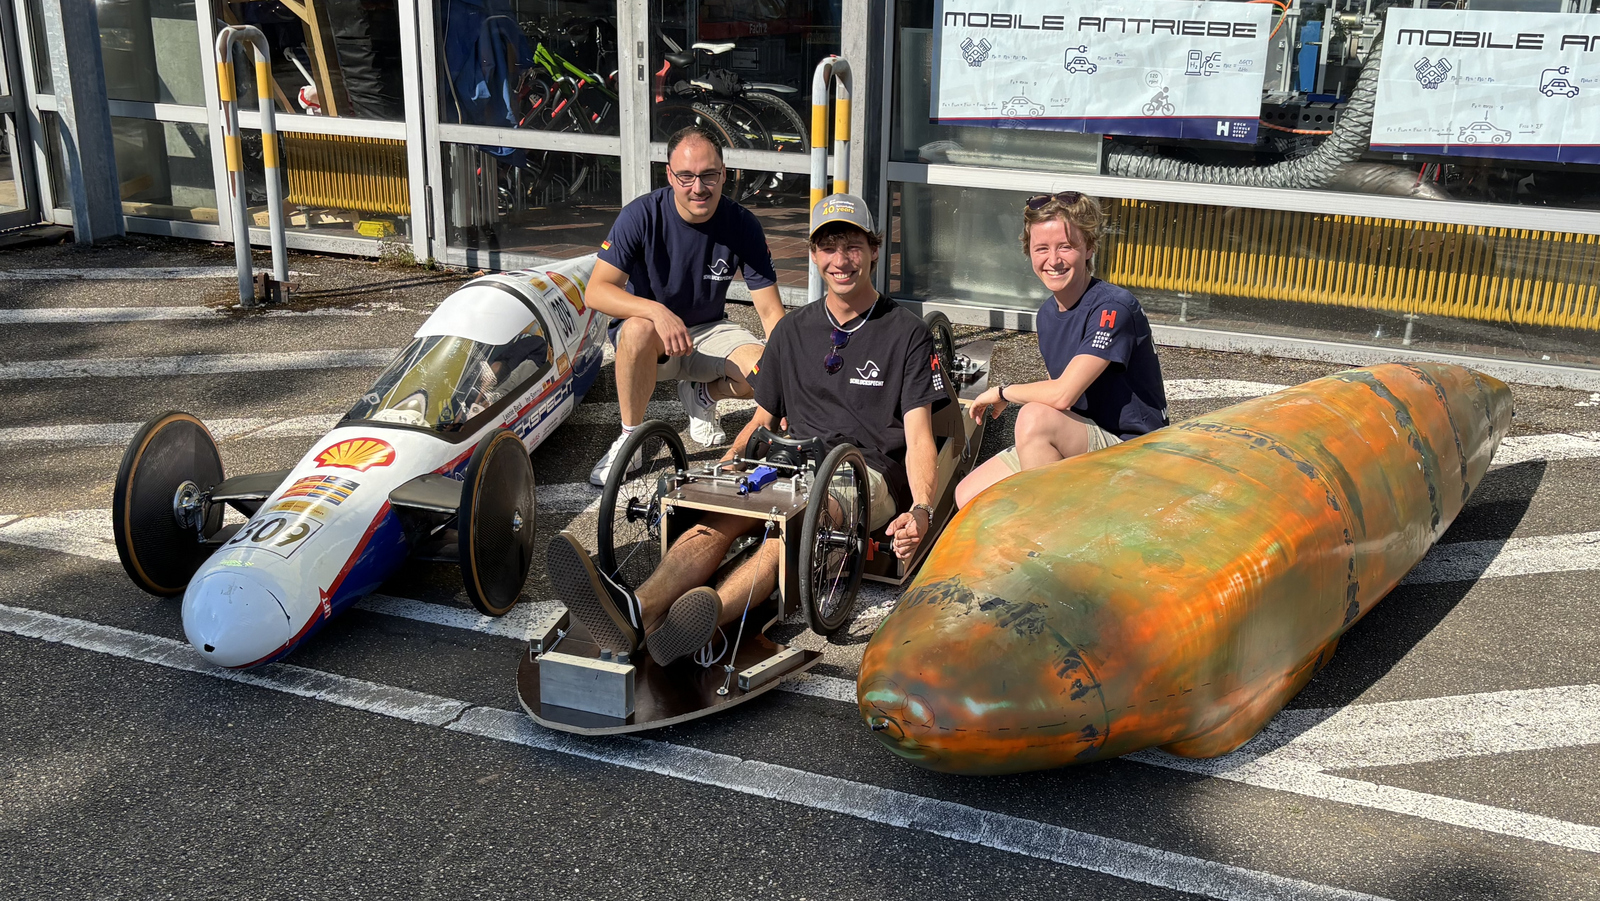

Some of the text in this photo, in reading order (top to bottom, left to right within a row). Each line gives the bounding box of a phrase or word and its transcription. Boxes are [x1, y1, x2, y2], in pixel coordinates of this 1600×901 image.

[944, 11, 1257, 38] MOBILE ANTRIEBE
[1397, 28, 1545, 50] MOBILE
[822, 205, 835, 215] 40
[229, 517, 311, 547] 309
